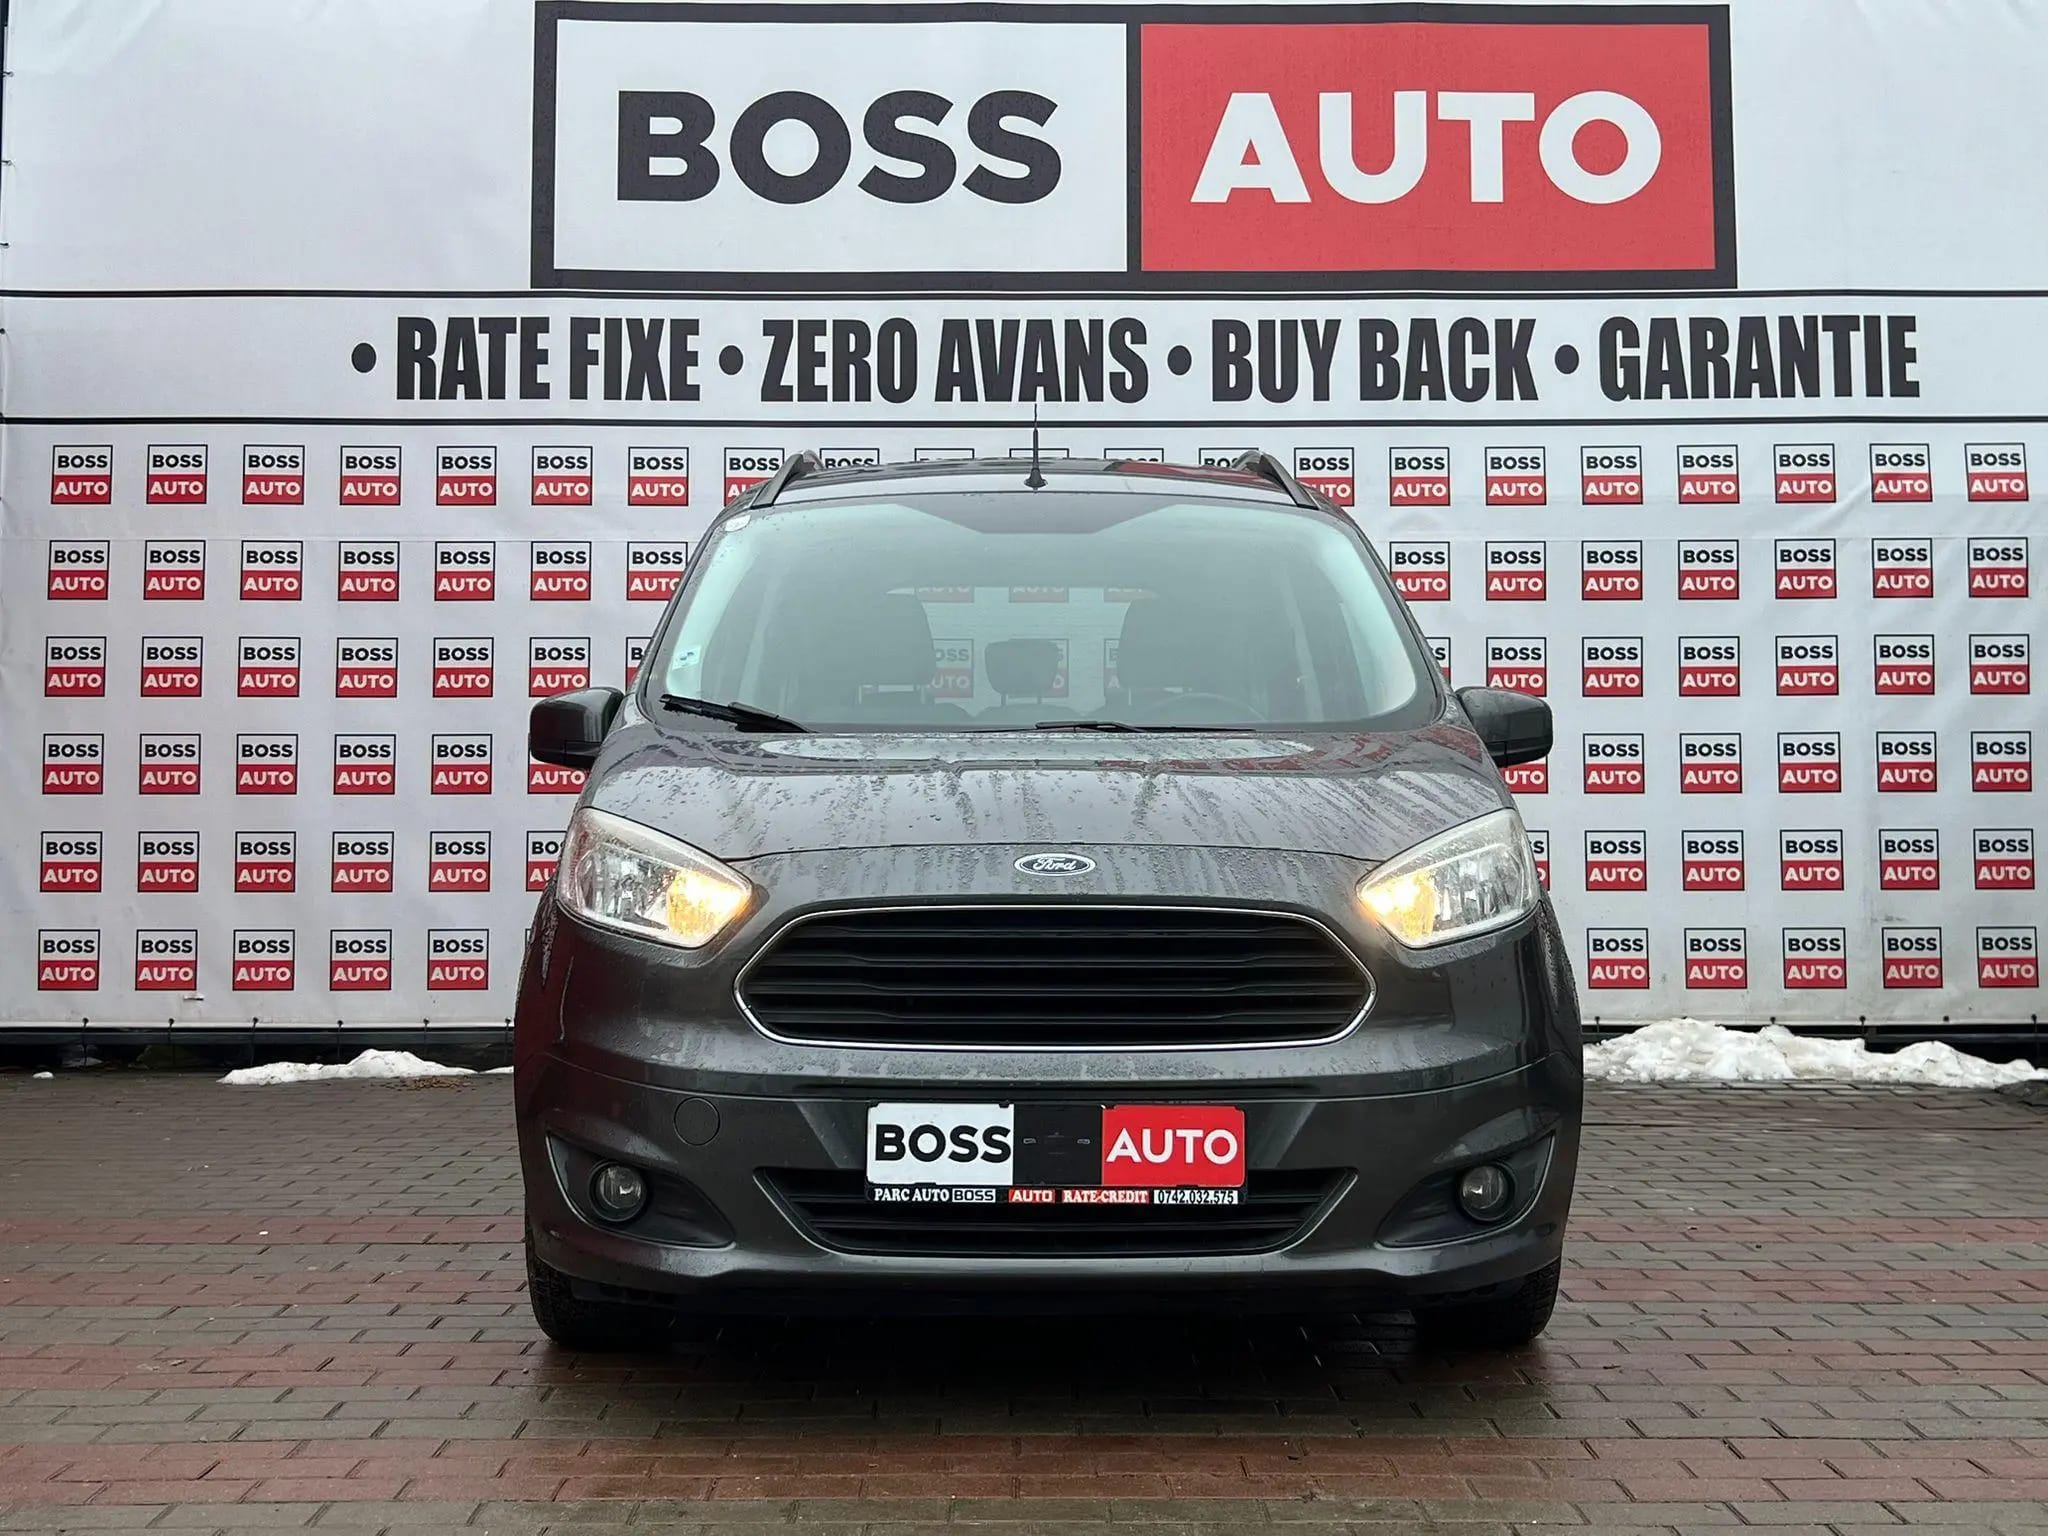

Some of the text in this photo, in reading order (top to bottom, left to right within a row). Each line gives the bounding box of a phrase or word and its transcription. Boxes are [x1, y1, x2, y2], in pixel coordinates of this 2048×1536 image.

[618, 90, 1661, 204] BOSS AUTO
[397, 315, 1920, 403] RATE FIXE ZERO AVANS BUY BACK GARANTIE
[57, 454, 108, 469] BOSS
[152, 454, 203, 469] BOSS
[248, 454, 300, 469] BOSS
[345, 455, 397, 470] BOSS
[441, 455, 492, 470] BOSS
[537, 455, 588, 470] BOSS
[633, 456, 684, 471] BOSS
[729, 457, 780, 471] BOSS
[1299, 456, 1350, 471] BOSS
[1394, 456, 1446, 471] BOSS
[1490, 456, 1541, 470] BOSS
[1586, 455, 1638, 470] BOSS
[1682, 454, 1734, 468] BOSS
[1779, 453, 1831, 467] BOSS
[1875, 453, 1926, 467] BOSS
[1971, 452, 2022, 466] BOSS
[54, 481, 109, 496] AUTO
[149, 480, 204, 495] AUTO
[245, 481, 301, 496] AUTO
[343, 482, 398, 497] AUTO
[439, 482, 493, 497] AUTO
[535, 482, 590, 497] AUTO
[631, 483, 686, 497] AUTO
[1393, 483, 1447, 498] AUTO
[1488, 482, 1544, 497] AUTO
[1585, 481, 1640, 496] AUTO
[1681, 480, 1736, 495] AUTO
[1778, 479, 1833, 494] AUTO
[1874, 479, 1929, 494] AUTO
[1971, 478, 2025, 493] AUTO
[54, 549, 105, 564] BOSS
[149, 549, 201, 564] BOSS
[246, 550, 298, 565] BOSS
[440, 550, 491, 565] BOSS
[536, 550, 587, 565] BOSS
[631, 550, 684, 565] BOSS
[1394, 551, 1446, 565] BOSS
[1490, 550, 1542, 565] BOSS
[1586, 550, 1638, 564] BOSS
[1683, 549, 1735, 564] BOSS
[1780, 548, 1832, 563] BOSS
[1877, 547, 1928, 562] BOSS
[1973, 547, 2024, 561] BOSS
[50, 576, 105, 591] AUTO
[146, 576, 202, 591] AUTO
[243, 577, 299, 592] AUTO
[438, 577, 492, 592] AUTO
[533, 577, 588, 592] AUTO
[1489, 577, 1543, 592] AUTO
[1585, 577, 1640, 592] AUTO
[1681, 576, 1736, 591] AUTO
[1778, 575, 1834, 590] AUTO
[1876, 574, 1930, 589] AUTO
[1972, 574, 2025, 589] AUTO
[50, 646, 102, 661] BOSS
[146, 646, 198, 661] BOSS
[243, 646, 296, 661] BOSS
[341, 647, 394, 662] BOSS
[438, 647, 489, 661] BOSS
[534, 646, 586, 661] BOSS
[1491, 646, 1542, 661] BOSS
[1587, 646, 1639, 661] BOSS
[1684, 646, 1736, 660] BOSS
[1879, 644, 1930, 659] BOSS
[1974, 644, 2025, 658] BOSS
[47, 673, 102, 688] AUTO
[143, 673, 199, 688] AUTO
[240, 673, 297, 688] AUTO
[339, 674, 394, 689] AUTO
[435, 674, 490, 689] AUTO
[532, 673, 587, 688] AUTO
[1586, 673, 1640, 688] AUTO
[1682, 673, 1737, 688] AUTO
[1878, 671, 1932, 686] AUTO
[1973, 671, 2027, 686] AUTO
[48, 743, 99, 758] BOSS
[144, 743, 196, 758] BOSS
[241, 743, 294, 758] BOSS
[339, 744, 391, 758] BOSS
[436, 743, 488, 758] BOSS
[1588, 743, 1640, 758] BOSS
[1685, 743, 1737, 757] BOSS
[1784, 742, 1836, 756] BOSS
[1882, 741, 1932, 756] BOSS
[1976, 741, 2027, 755] BOSS
[45, 771, 100, 786] AUTO
[142, 770, 197, 786] AUTO
[239, 771, 294, 786] AUTO
[336, 771, 392, 786] AUTO
[434, 771, 489, 786] AUTO
[530, 770, 583, 785] AUTO
[1587, 770, 1642, 785] AUTO
[1683, 769, 1739, 785] AUTO
[1781, 769, 1838, 784] AUTO
[1881, 768, 1934, 783] AUTO
[1975, 768, 2029, 783] AUTO
[45, 841, 98, 856] BOSS
[143, 841, 195, 856] BOSS
[337, 841, 389, 856] BOSS
[435, 841, 486, 856] BOSS
[1590, 840, 1642, 855] BOSS
[1687, 840, 1739, 854] BOSS
[1884, 839, 1935, 854] BOSS
[1978, 838, 2030, 853] BOSS
[1033, 858, 1077, 870] Ford
[43, 868, 98, 883] AUTO
[140, 868, 196, 883] AUTO
[334, 868, 390, 883] AUTO
[432, 868, 487, 883] AUTO
[1589, 867, 1644, 882] AUTO
[1686, 867, 1741, 882] AUTO
[1883, 866, 1937, 881] AUTO
[1978, 866, 2032, 881] AUTO
[43, 939, 95, 954] BOSS
[141, 939, 193, 954] BOSS
[238, 939, 291, 954] BOSS
[335, 939, 387, 954] BOSS
[432, 939, 484, 954] BOSS
[1592, 938, 1644, 953] BOSS
[1690, 938, 1742, 952] BOSS
[1788, 937, 1841, 952] BOSS
[1887, 937, 1938, 952] BOSS
[1982, 936, 2033, 951] BOSS
[40, 966, 96, 982] AUTO
[138, 967, 194, 982] AUTO
[235, 967, 291, 982] AUTO
[332, 967, 388, 982] AUTO
[430, 966, 485, 981] AUTO
[1591, 965, 1646, 980] AUTO
[1689, 965, 1744, 980] AUTO
[1787, 965, 1844, 980] AUTO
[1886, 964, 1940, 980] AUTO
[1981, 964, 2036, 979] AUTO
[875, 1123, 1238, 1165] BOSS AUTO
[874, 1188, 910, 1201] PARC
[912, 1188, 950, 1201] AUTO
[953, 1189, 994, 1201] BOSS
[1010, 1189, 1053, 1201] AUTO
[1158, 1190, 1234, 1204] 0742.032.575
